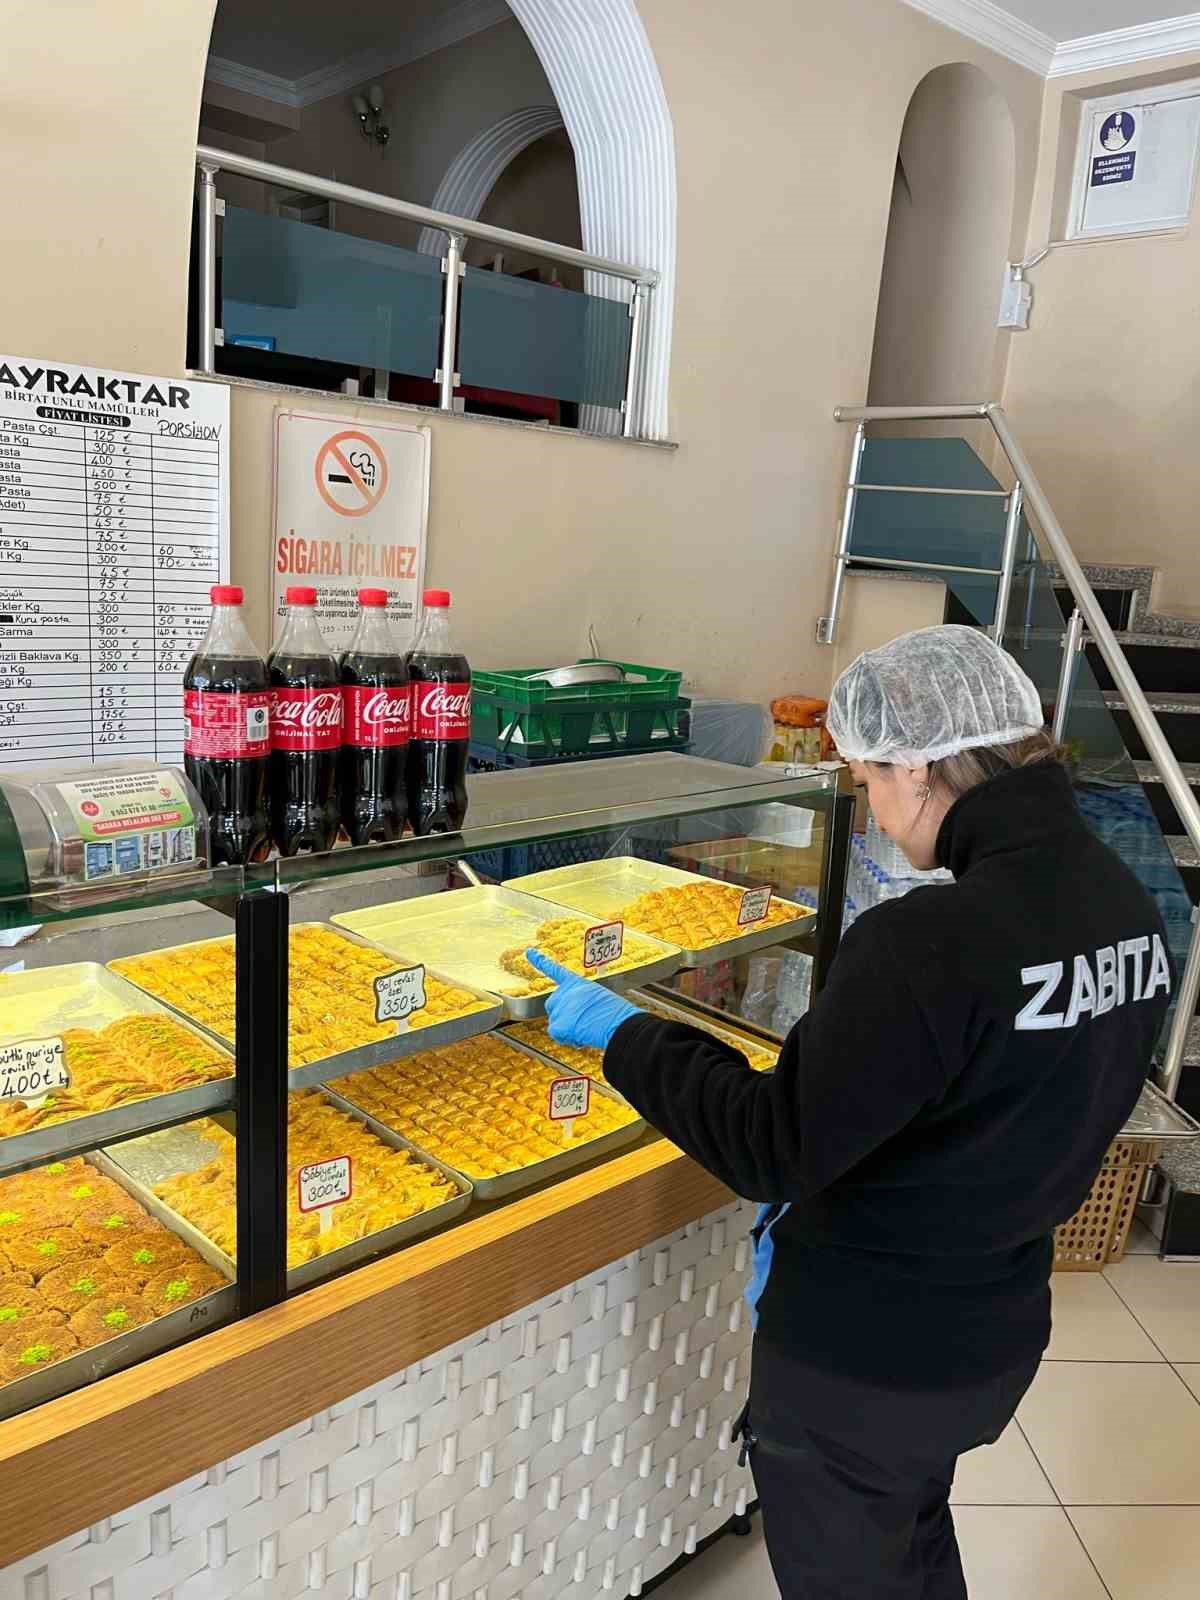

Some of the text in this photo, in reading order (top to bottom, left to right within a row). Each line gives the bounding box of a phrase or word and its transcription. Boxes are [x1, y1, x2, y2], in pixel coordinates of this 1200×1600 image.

[88, 400, 159, 418] MAMÜLLERİ
[278, 529, 417, 582] SİGARA İÇİLMEZ
[1014, 933, 1171, 1030] ZABITA
